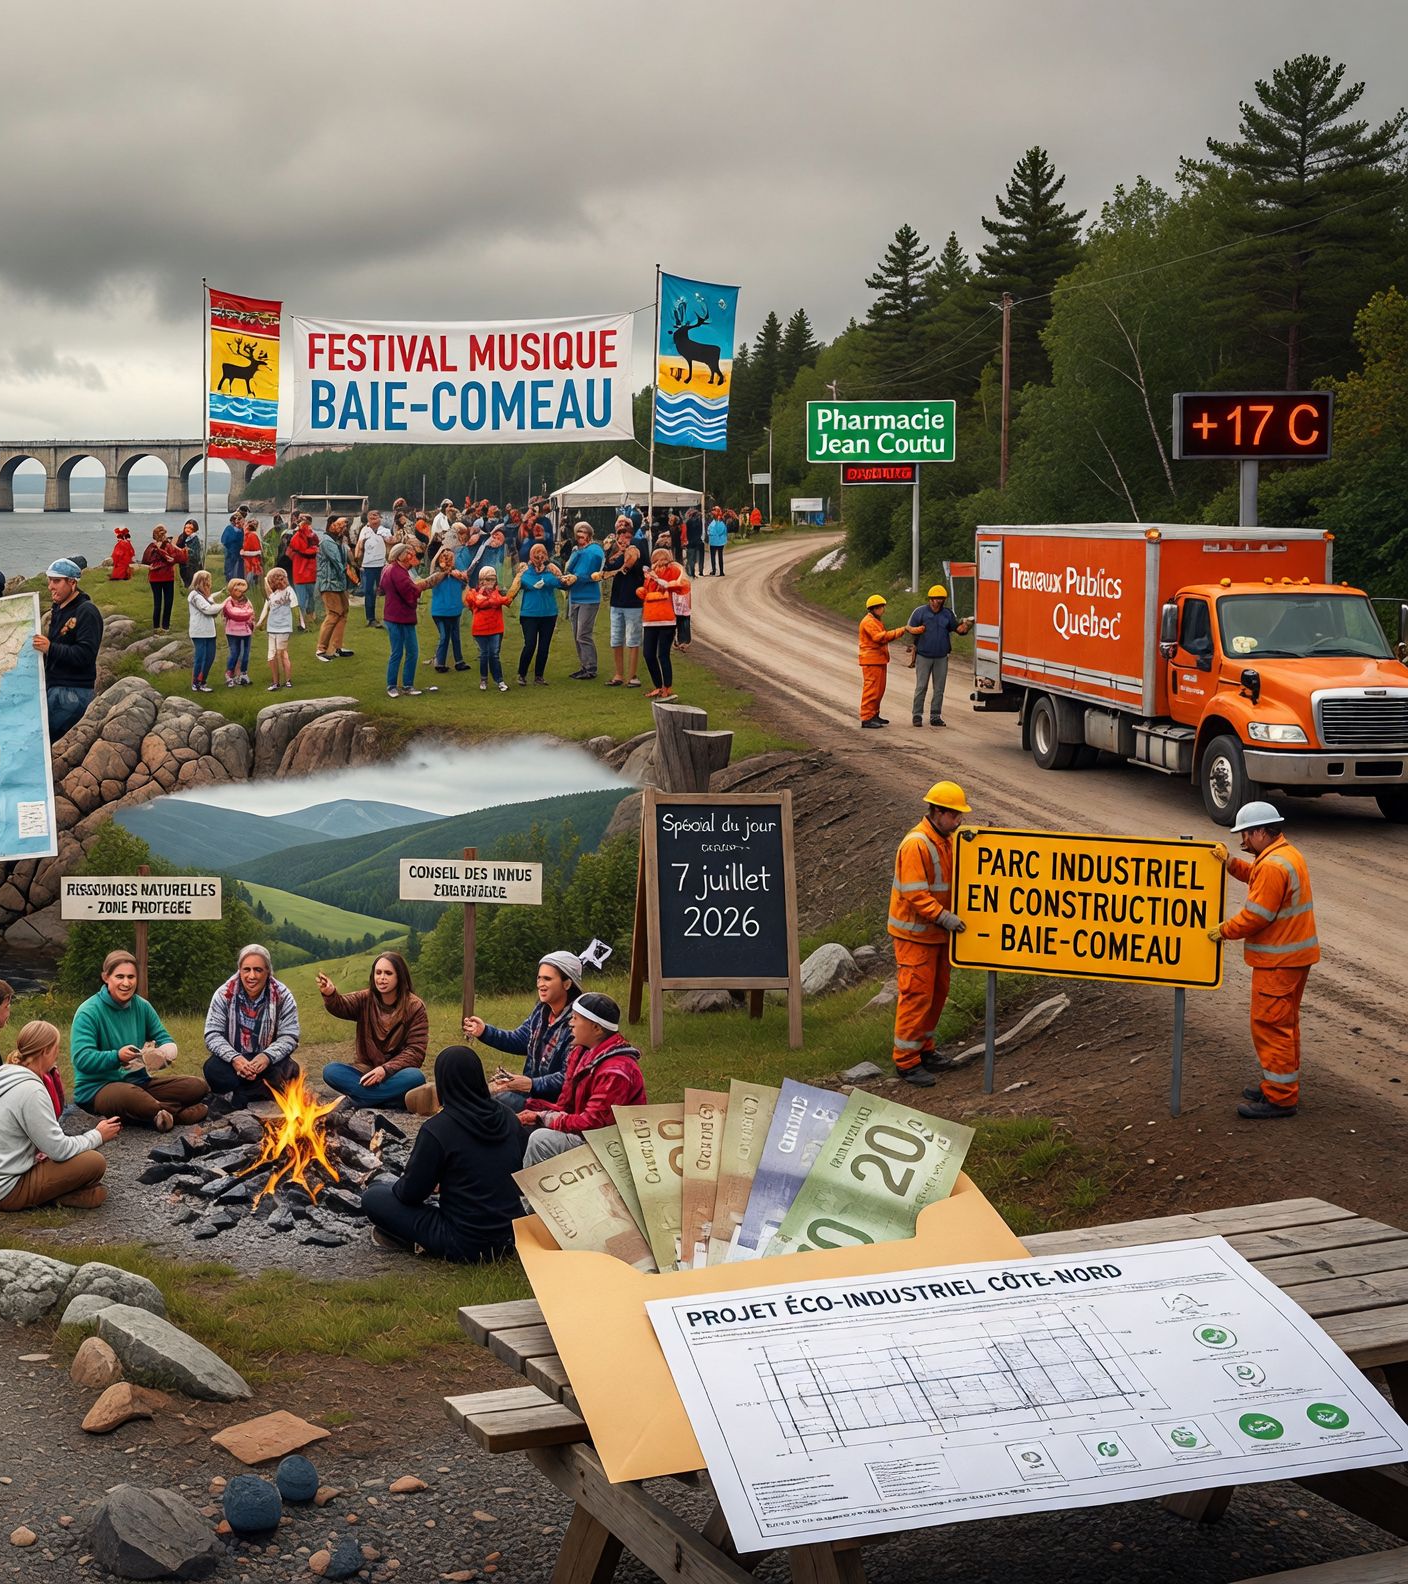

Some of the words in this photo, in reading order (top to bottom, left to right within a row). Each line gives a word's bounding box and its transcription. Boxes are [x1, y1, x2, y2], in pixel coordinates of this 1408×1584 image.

[307, 333, 458, 372] FESTIVAL
[469, 330, 618, 372] MUSIQUE
[310, 377, 613, 431] BAIE-COMEAU
[817, 408, 945, 430] Pharmacie
[815, 433, 870, 455] Jean
[877, 432, 945, 454] Coutu
[1192, 405, 1274, 446] +17
[1288, 403, 1320, 446] C
[721, 813, 740, 832] du
[741, 816, 777, 841] jour
[409, 865, 460, 879] CONSEIL
[464, 867, 488, 880] DES
[493, 867, 532, 881] INNUS
[671, 863, 690, 891] 7
[695, 862, 771, 901] juillet
[977, 847, 1040, 879] PARC
[1051, 852, 1205, 890] INDUSTRIEL
[97, 901, 128, 914] ZONE
[141, 883, 216, 897] NATURELLES
[967, 883, 999, 913] EN
[1009, 886, 1207, 929] CONSTRUCTION
[683, 906, 760, 937] 2026
[1001, 923, 1182, 965] BAIE-COMEAU
[850, 1124, 926, 1197] 20
[686, 1302, 778, 1327] PROJET
[784, 1279, 986, 1316] ÉCO-INDUSTRIEL
[988, 1264, 1123, 1292] CÔTE-NORD
